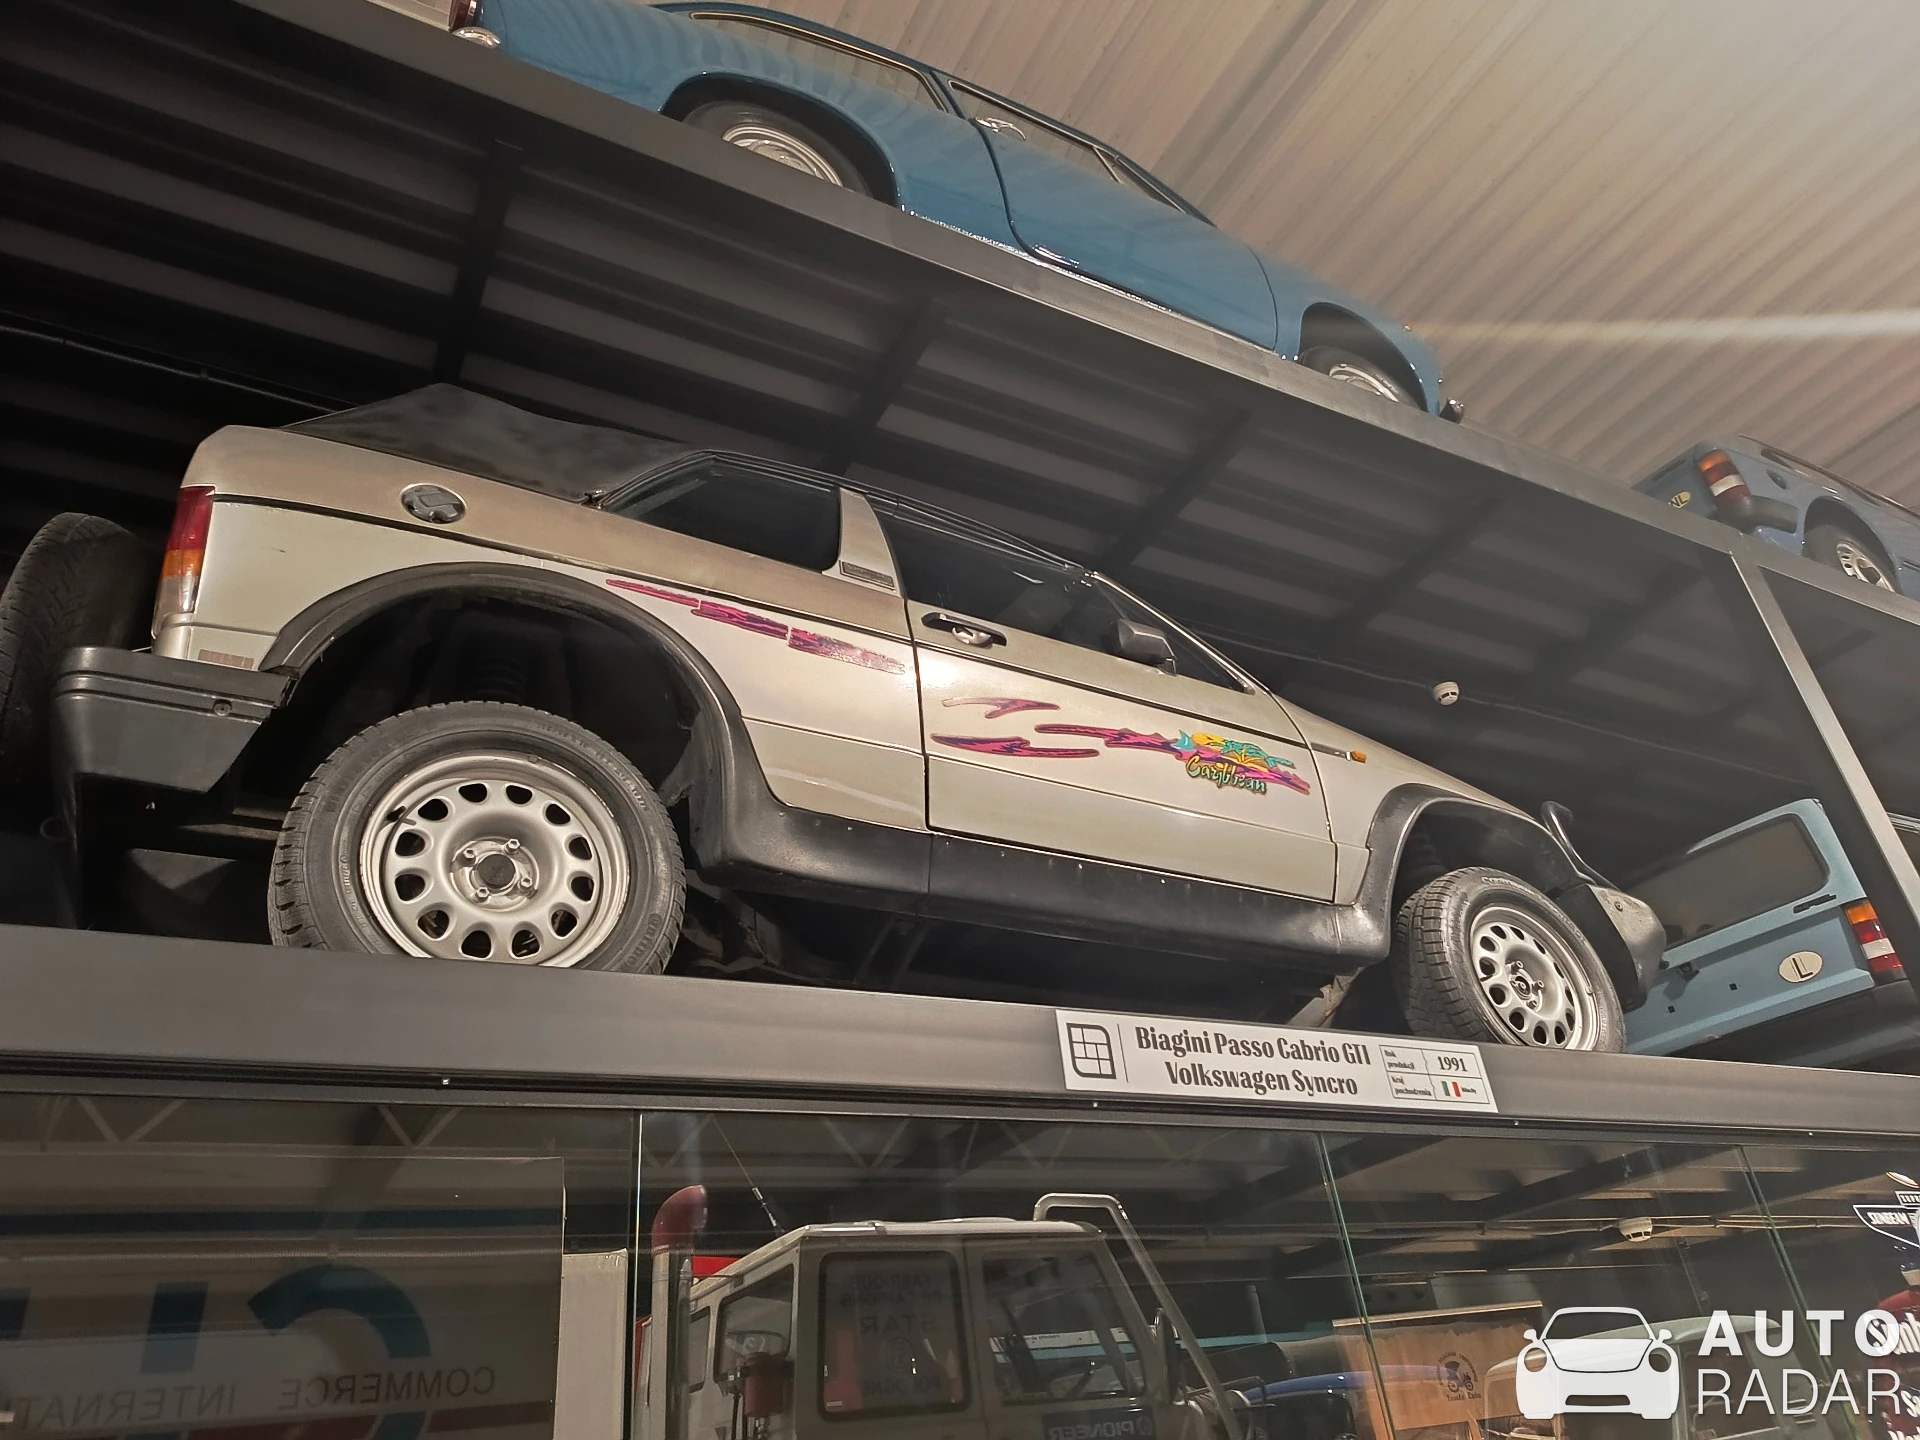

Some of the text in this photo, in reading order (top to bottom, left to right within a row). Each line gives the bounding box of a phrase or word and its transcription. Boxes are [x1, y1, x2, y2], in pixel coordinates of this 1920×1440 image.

[1135, 1026, 1371, 1065] Biagini Passo Cabrio GTI
[1437, 1055, 1468, 1072] 1991
[1164, 1061, 1358, 1097] Volkswagen Syncro
